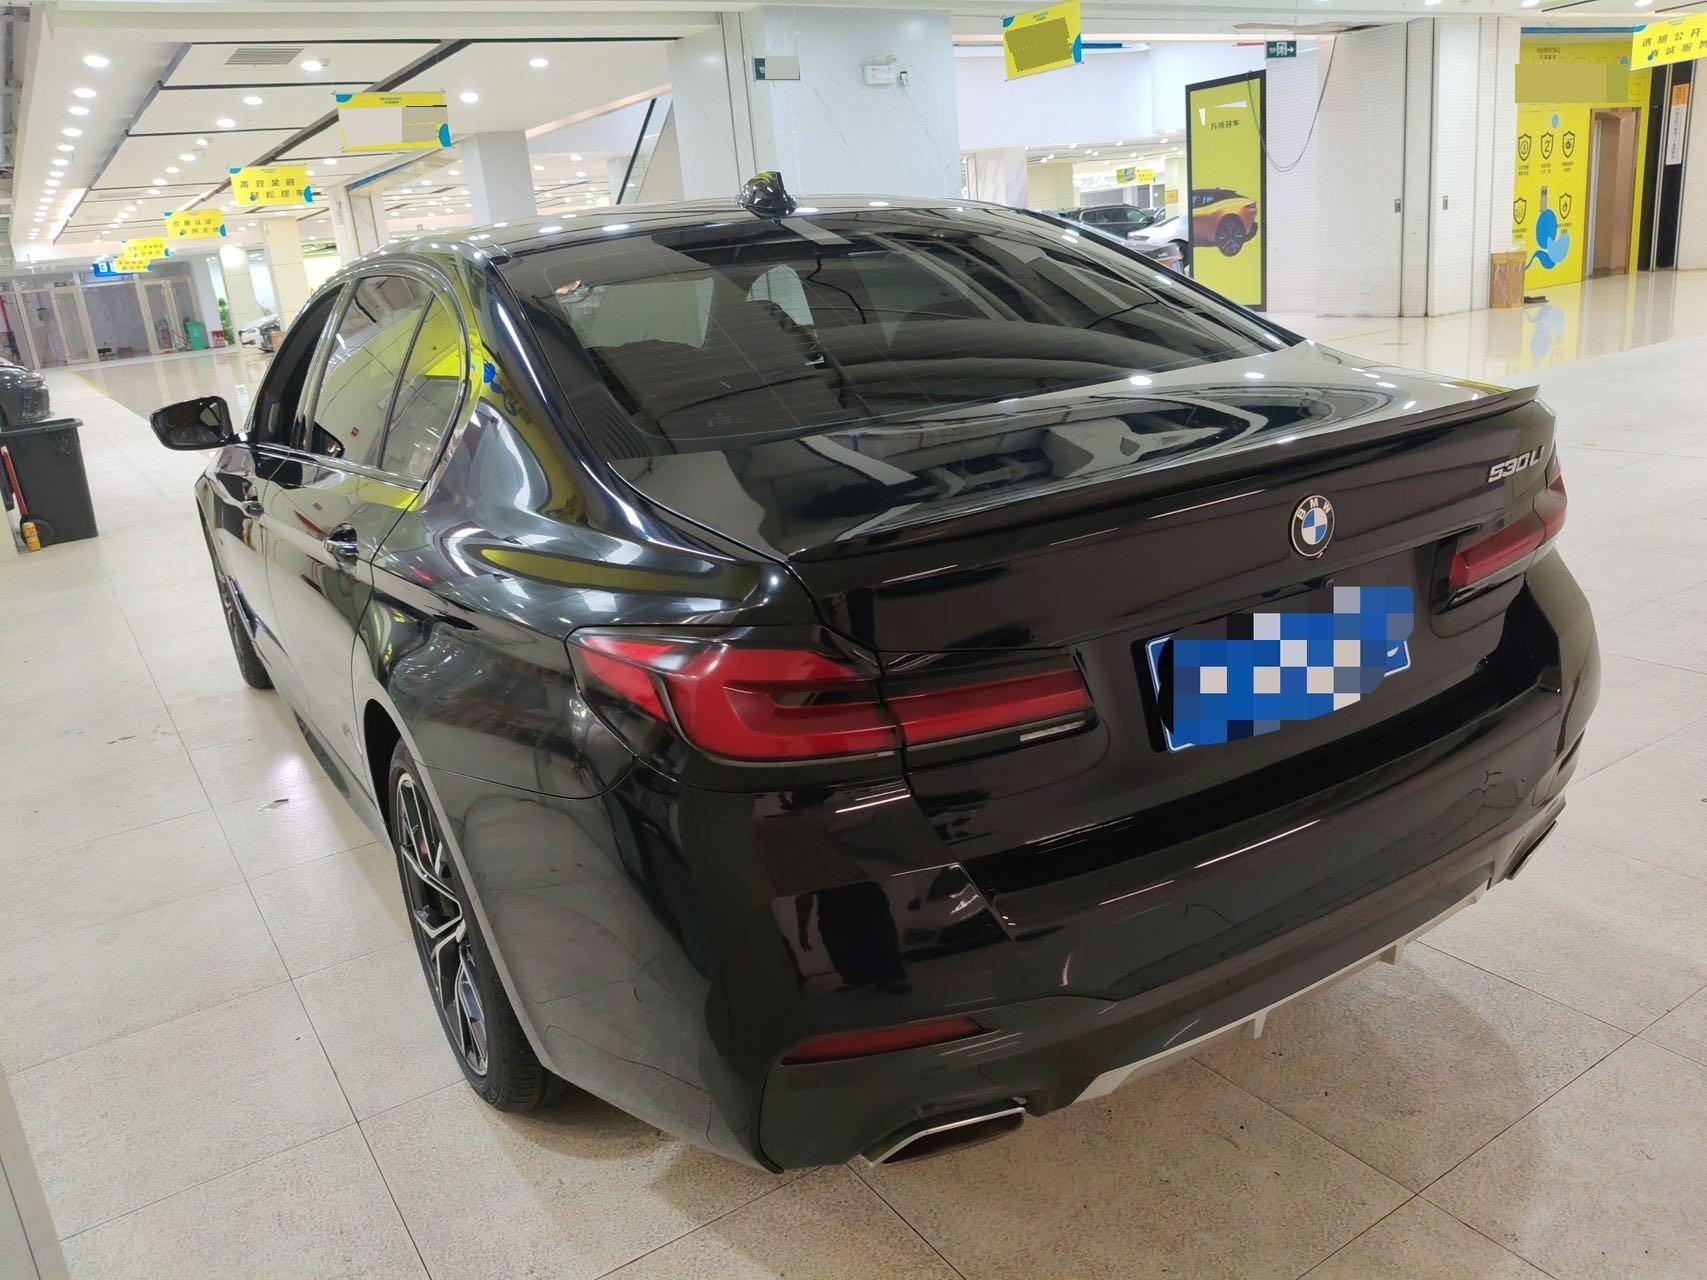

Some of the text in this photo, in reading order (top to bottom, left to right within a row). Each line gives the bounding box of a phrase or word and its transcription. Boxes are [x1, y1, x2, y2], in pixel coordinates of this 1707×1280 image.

[1642, 27, 1702, 47] 透明公开
[239, 178, 296, 189] 高效金融
[1296, 497, 1331, 521] BMW
